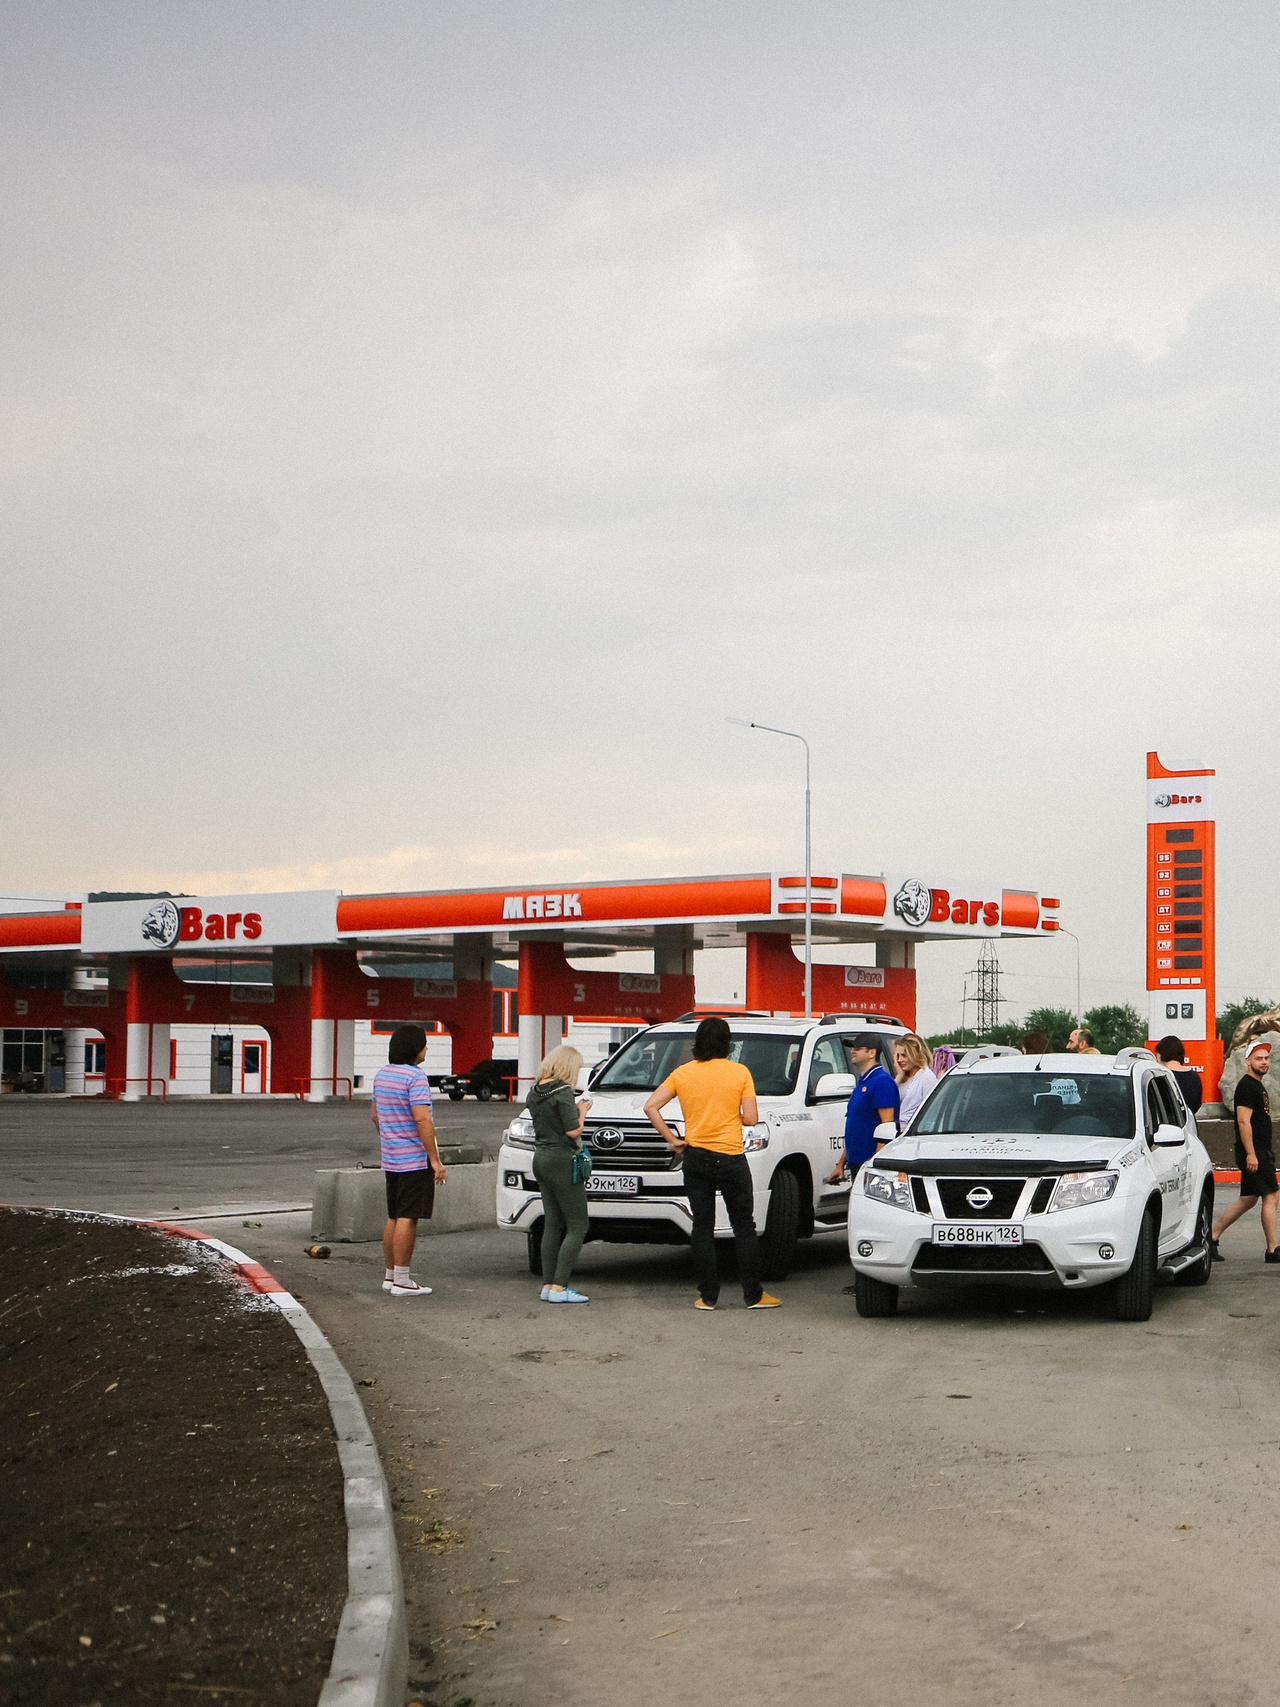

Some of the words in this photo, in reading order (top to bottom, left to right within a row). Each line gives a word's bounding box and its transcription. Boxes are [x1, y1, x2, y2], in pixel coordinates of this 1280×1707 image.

[1171, 794, 1202, 804] Bars
[503, 894, 582, 919] МАЗК
[931, 888, 999, 926] Bars
[179, 907, 262, 941] Bars
[858, 970, 882, 983] Bars
[366, 989, 379, 1007] 5
[574, 983, 585, 1002] 3
[15, 999, 29, 1016] 9
[183, 994, 195, 1012] 7
[618, 1178, 635, 1188] 126
[938, 1227, 993, 1242] В688НК
[997, 1227, 1019, 1239] 126
